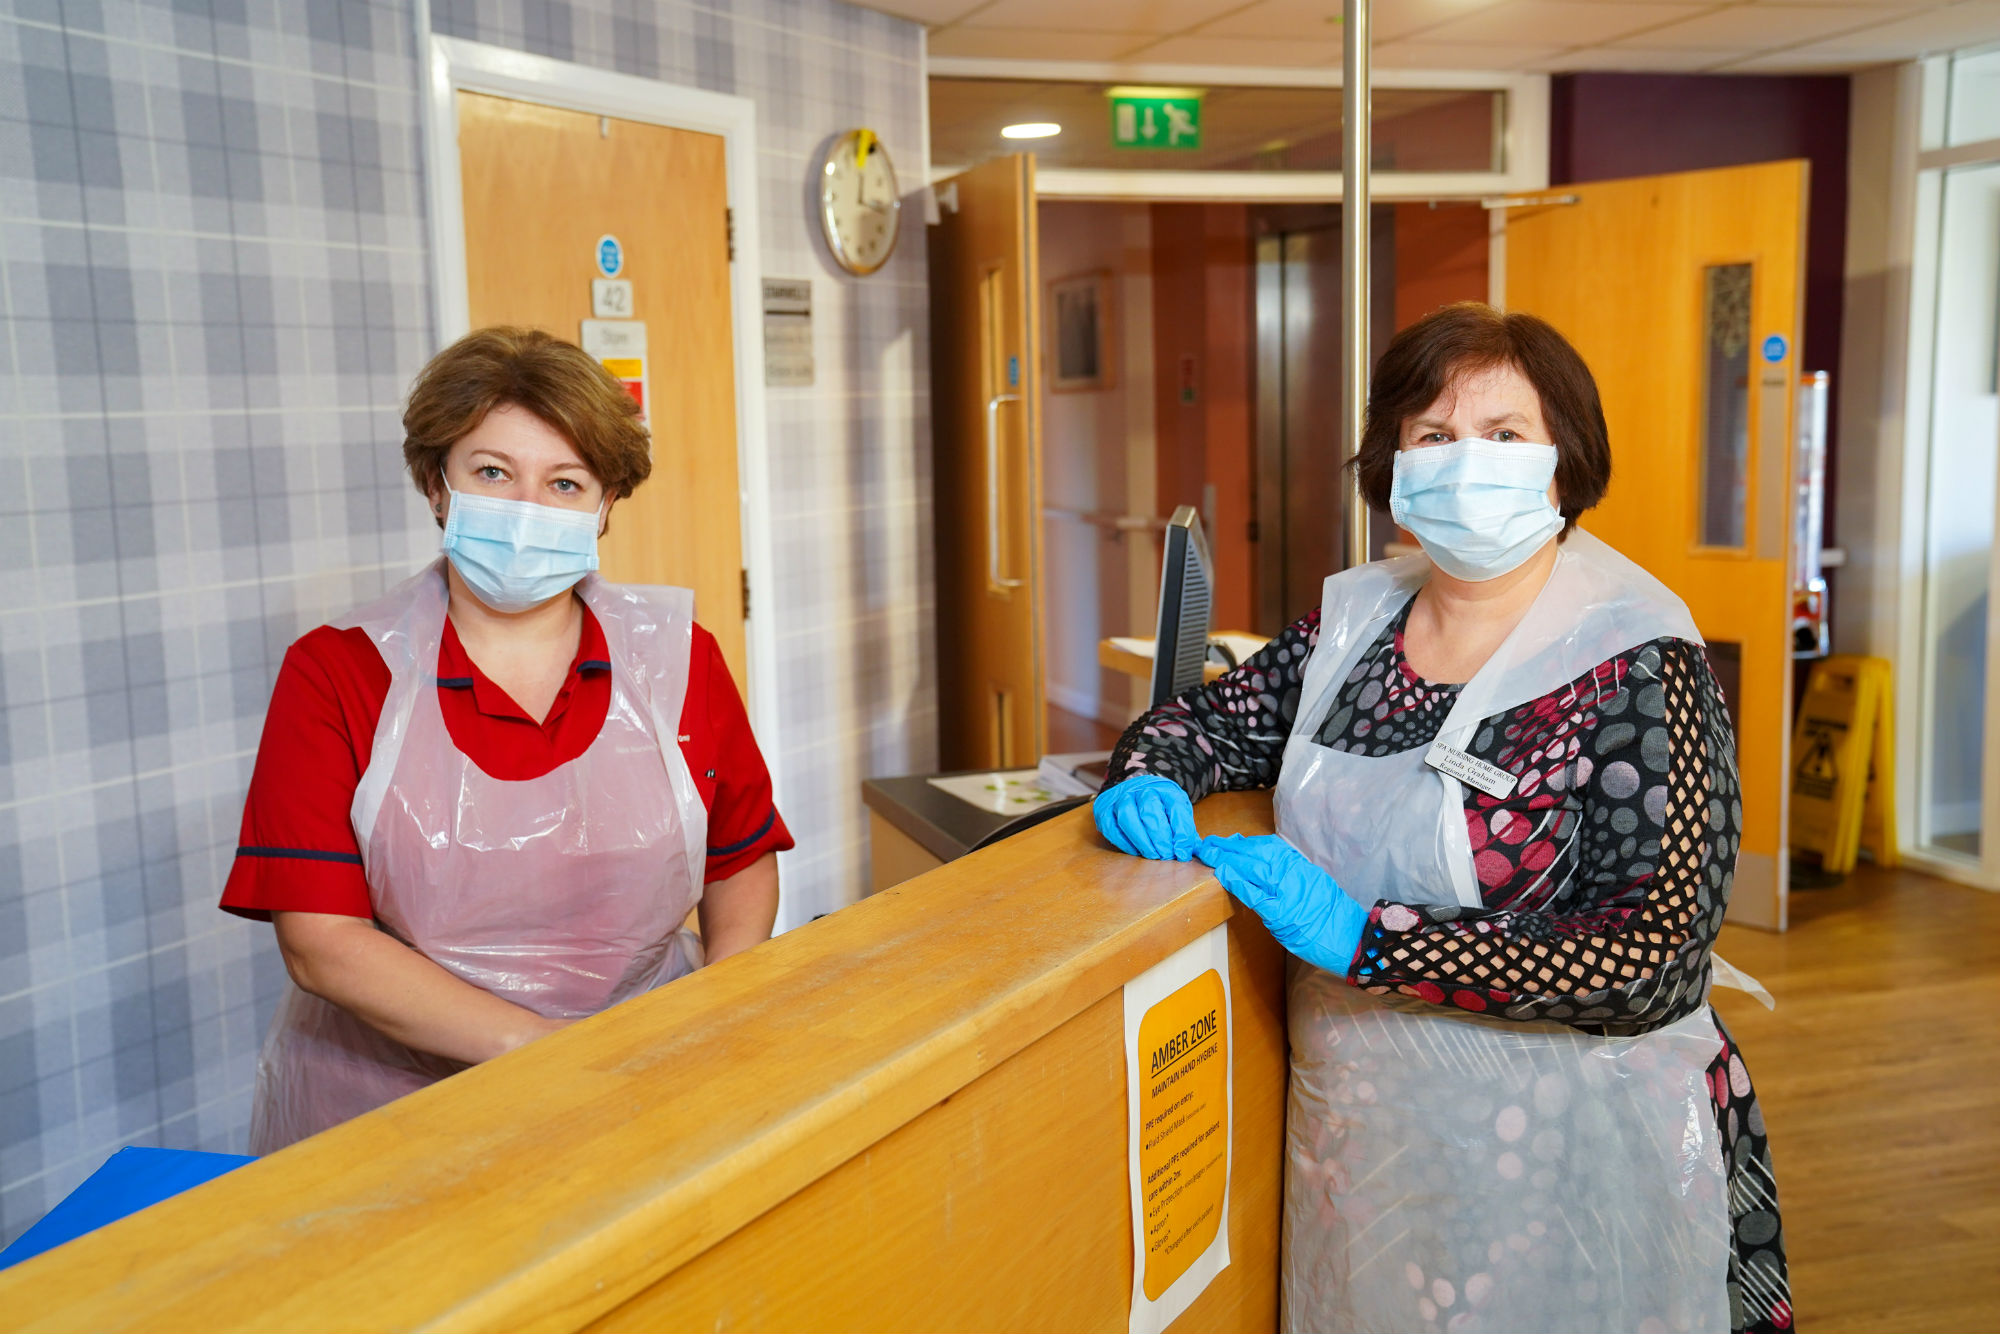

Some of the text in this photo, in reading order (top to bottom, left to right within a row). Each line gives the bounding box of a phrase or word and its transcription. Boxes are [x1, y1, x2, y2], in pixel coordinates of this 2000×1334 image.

[602, 286, 627, 313] 42
[1435, 742, 1516, 784] SPA NURSING HOME GROUP
[1439, 763, 1492, 792] Regional Manager
[1444, 756, 1496, 785] Linda Graham
[1151, 1009, 1217, 1073] AMBER ZONE
[1151, 1042, 1218, 1099] MAINTAIN HAND HYGIENE
[1145, 1119, 1154, 1132] PPE
[1154, 1104, 1174, 1125] required
[1173, 1101, 1180, 1110] on
[1148, 1114, 1185, 1150] Fluid Shield Mask
[1147, 1159, 1171, 1185] Additional
[1170, 1152, 1180, 1166] PPE
[1179, 1137, 1198, 1158] required
[1197, 1133, 1205, 1143] for
[1204, 1120, 1220, 1140] patient
[1148, 1189, 1158, 1202] care
[1158, 1176, 1173, 1193] within
[1152, 1205, 1161, 1217] Eye
[1183, 1225, 1192, 1238] after
[1201, 1202, 1214, 1222] patient
